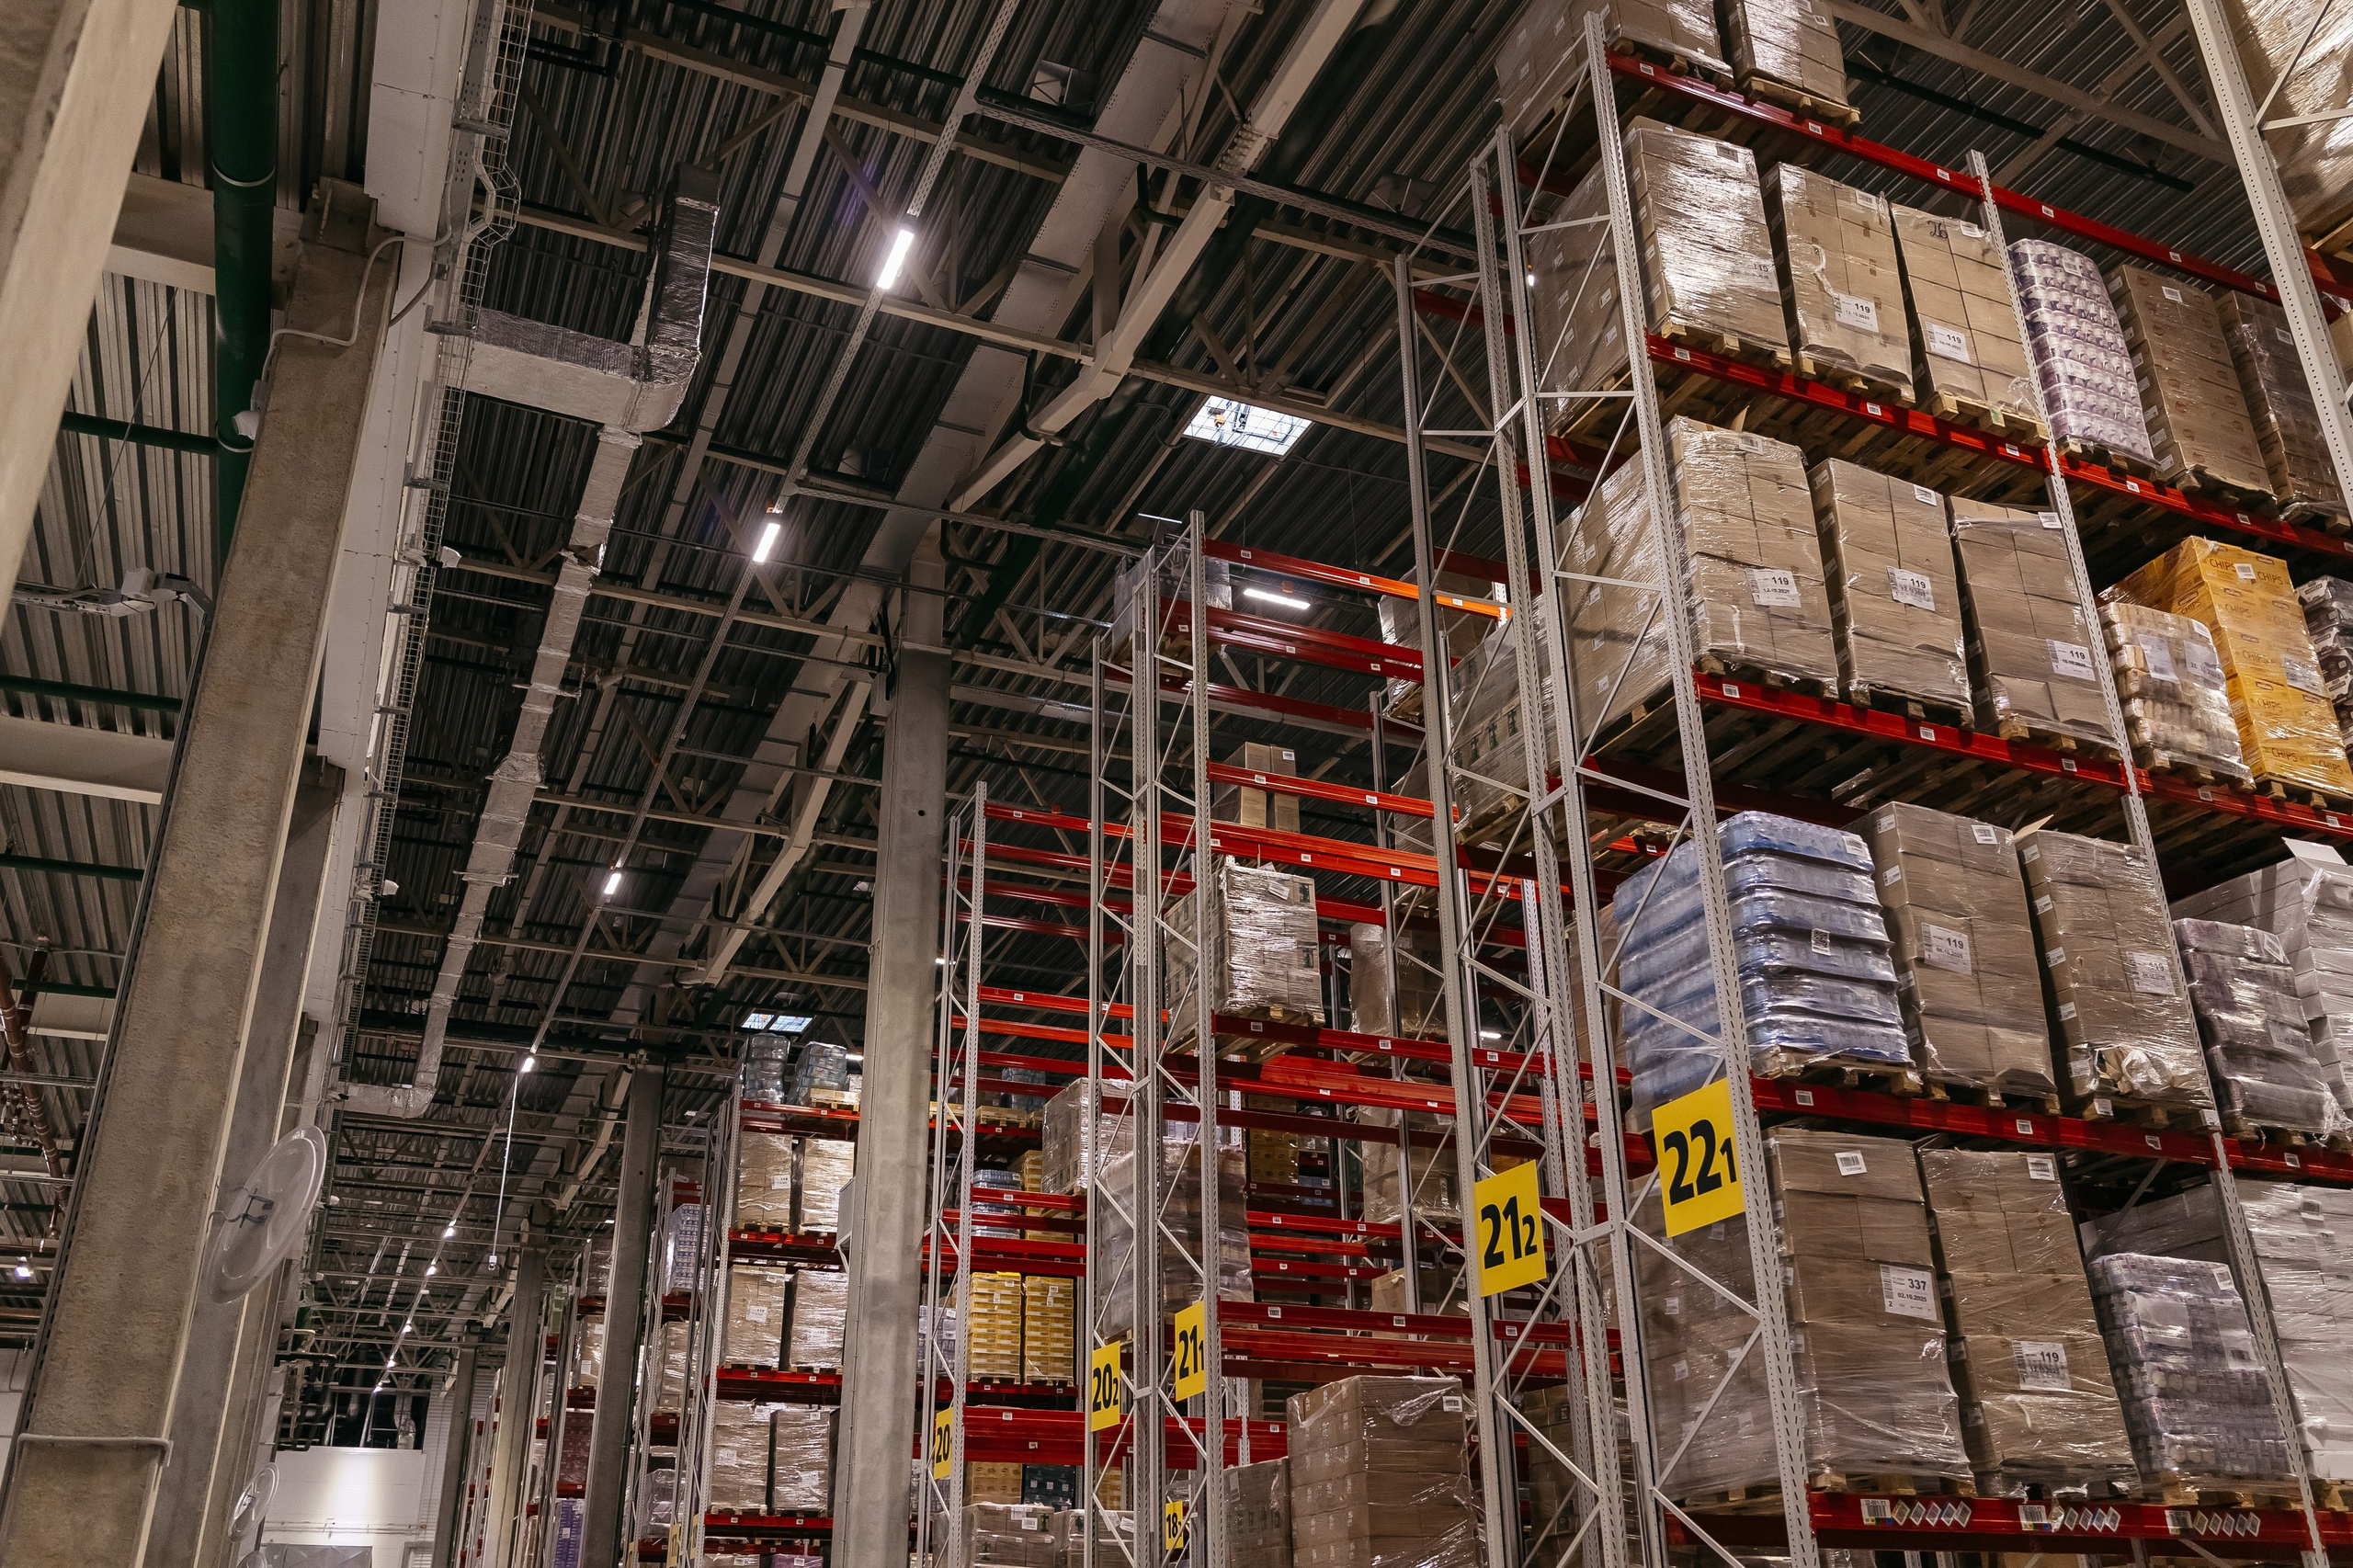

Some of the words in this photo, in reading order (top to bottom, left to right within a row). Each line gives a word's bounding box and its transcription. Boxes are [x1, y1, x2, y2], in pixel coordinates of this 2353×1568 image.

[1854, 302, 1870, 313] 119
[1946, 334, 1962, 345] 119
[1771, 576, 1790, 585] 119
[1910, 578, 1927, 589] 119
[2257, 571, 2284, 585] CHIPS
[2181, 598, 2202, 615] CHIPS
[2224, 603, 2252, 619] CHIPS
[2069, 650, 2086, 660] 119
[2256, 698, 2284, 713] CHIPS
[2271, 747, 2298, 763] CHIPS
[2318, 759, 2344, 775] CHIPS
[1946, 937, 1964, 949] 119
[1907, 1278, 1927, 1290] 337
[1897, 1291, 1927, 1302] 02.10.2025
[2040, 1351, 2060, 1363] 119
[936, 1423, 952, 1464] 20
